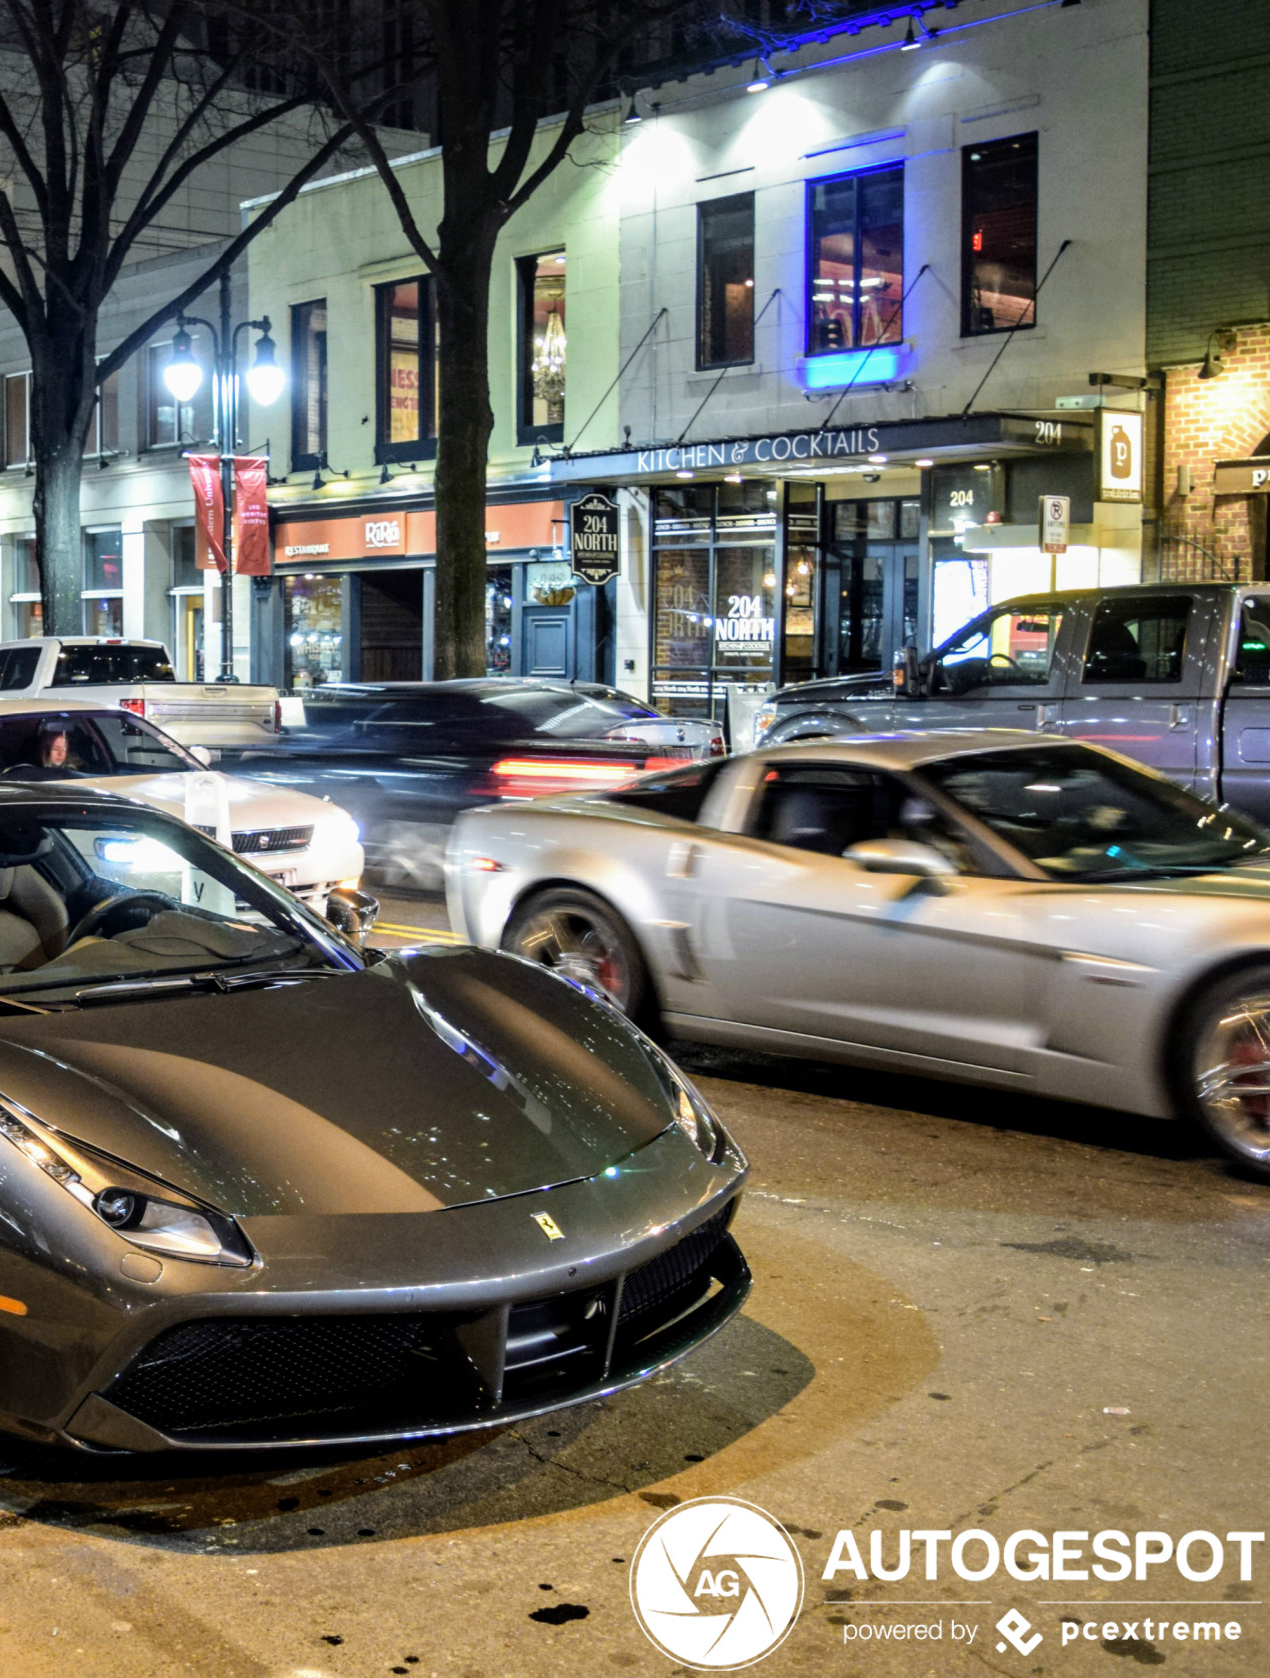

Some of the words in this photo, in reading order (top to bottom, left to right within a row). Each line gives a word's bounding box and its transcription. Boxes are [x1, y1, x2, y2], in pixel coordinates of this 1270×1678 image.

[1035, 421, 1062, 446] 204
[637, 444, 724, 472] KITCHEN
[731, 440, 749, 464] &
[754, 428, 879, 461] COCKTAILS
[949, 489, 975, 507] 204
[583, 515, 608, 533] 204
[574, 533, 618, 551] NORTH
[728, 595, 762, 618] 204
[715, 618, 775, 640] NORTH
